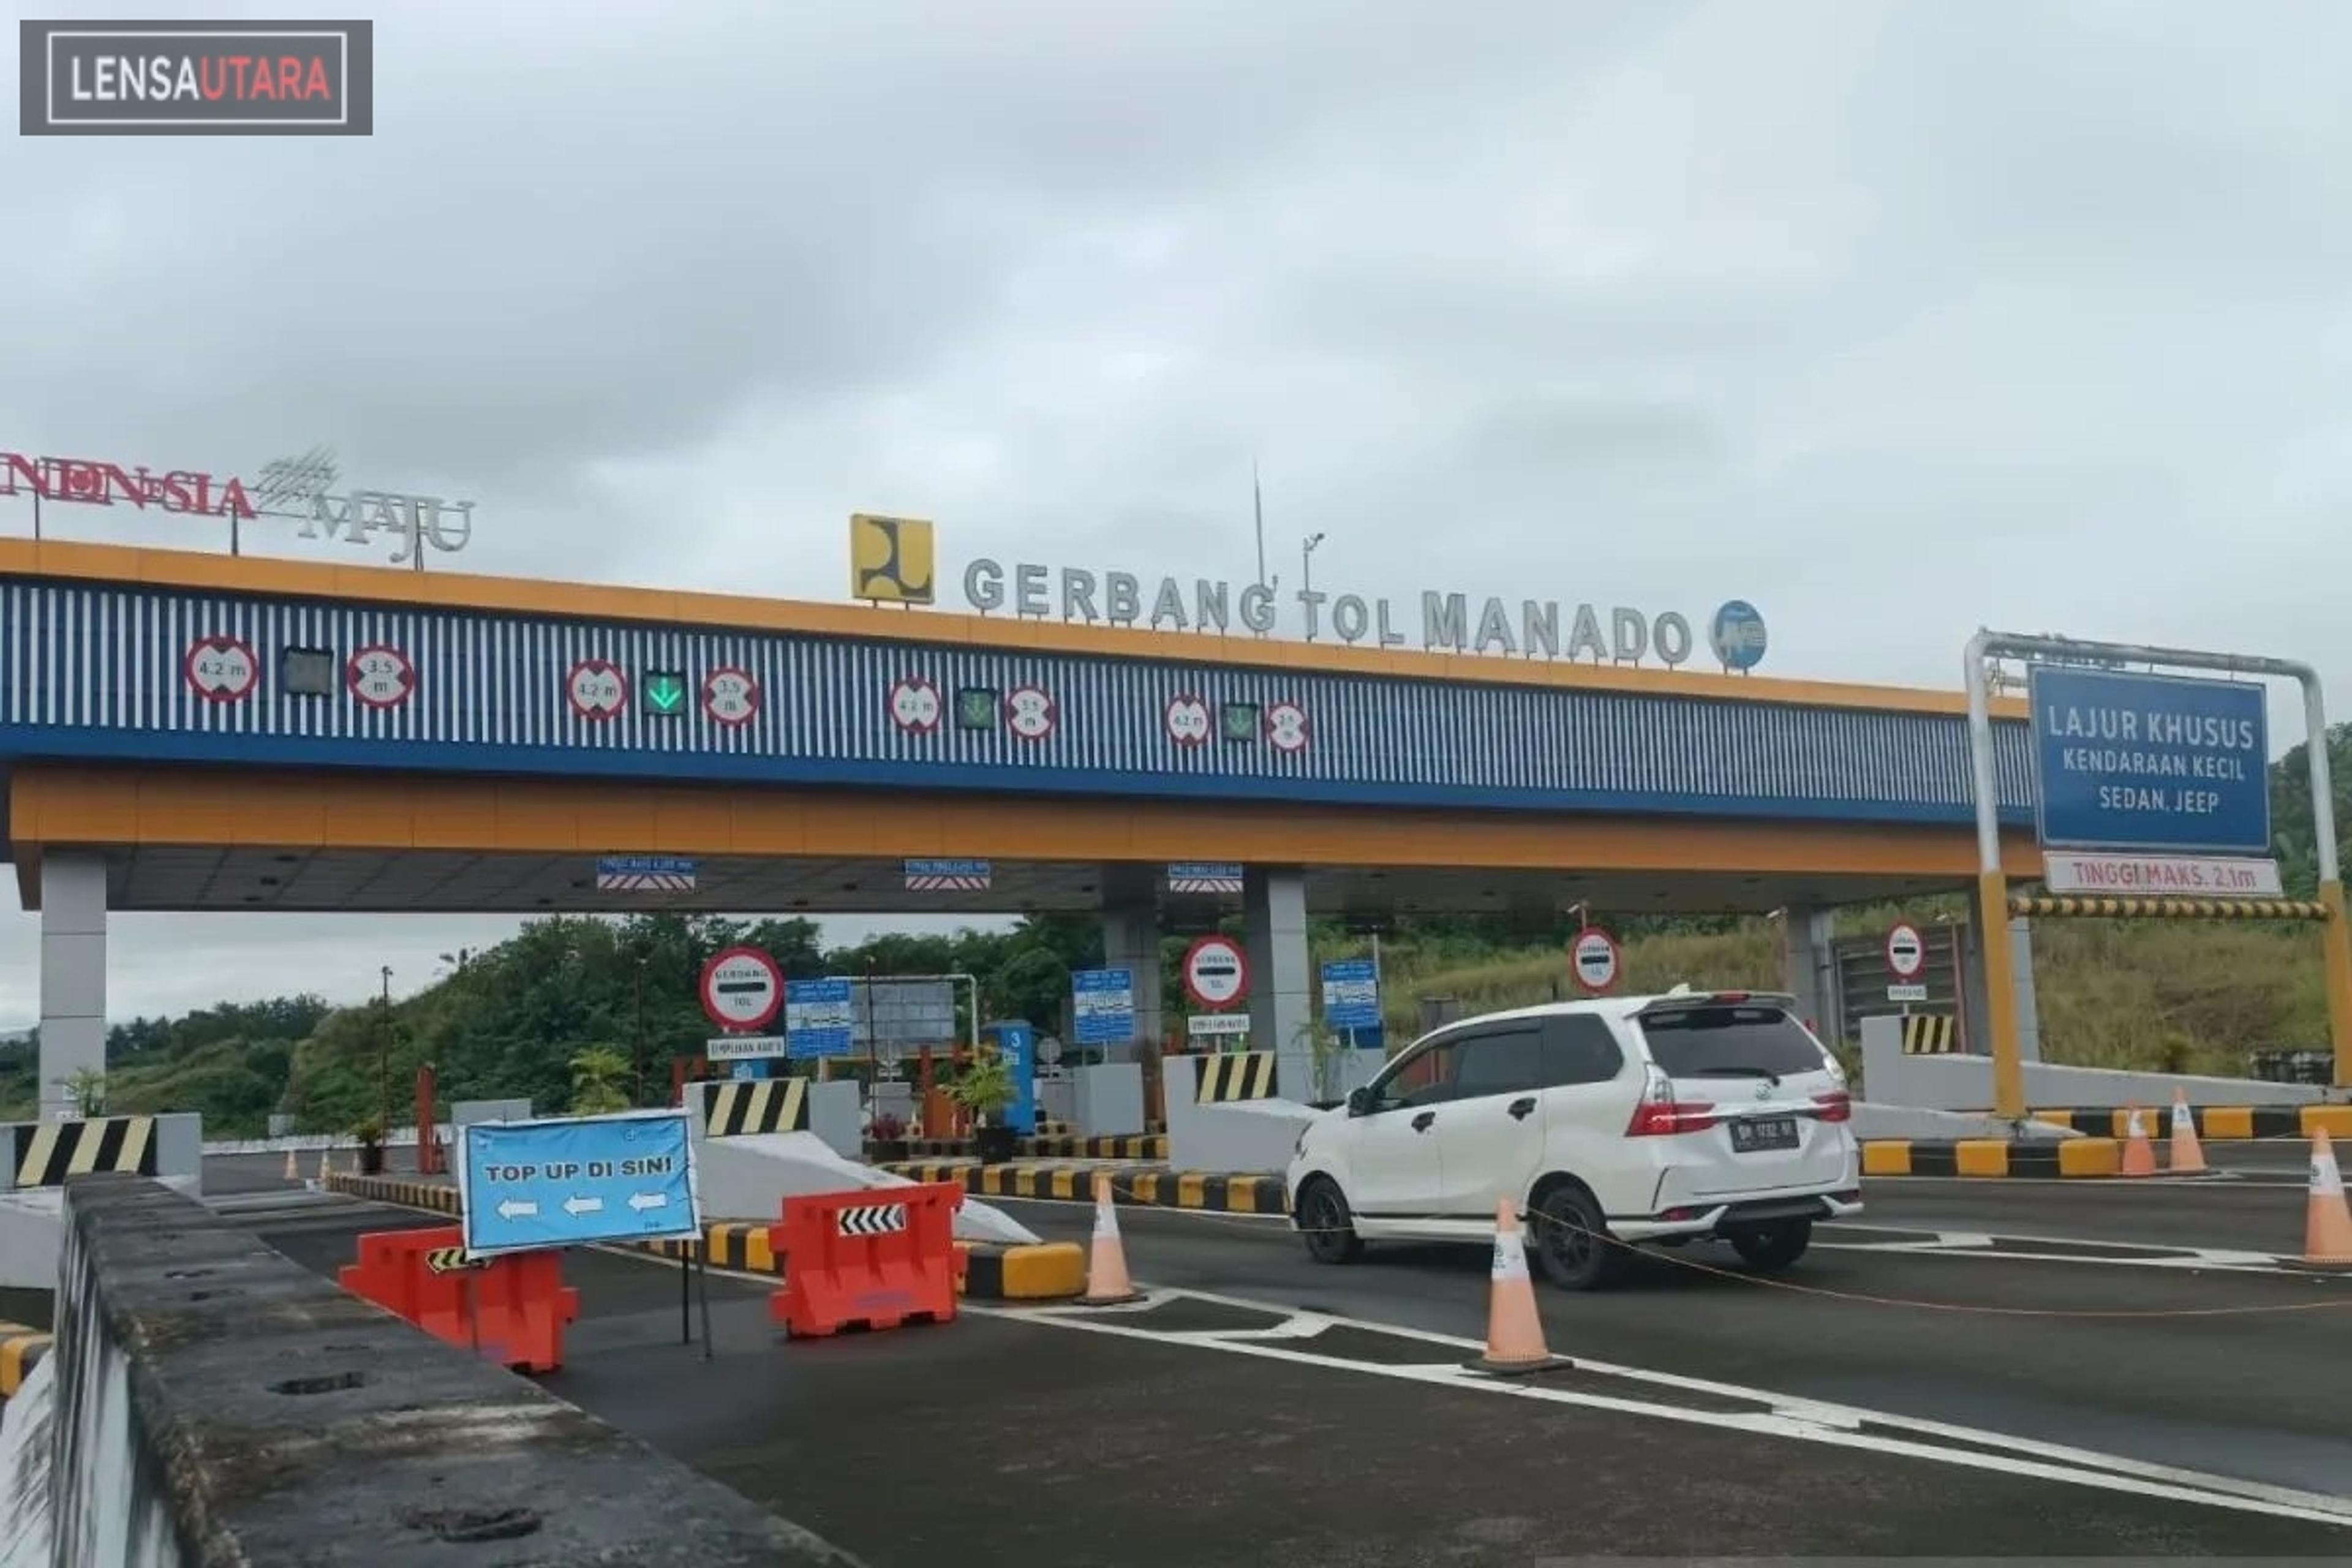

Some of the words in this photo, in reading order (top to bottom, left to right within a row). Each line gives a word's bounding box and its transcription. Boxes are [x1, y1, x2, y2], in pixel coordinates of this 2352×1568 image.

[298, 491, 476, 563] MAJU
[964, 558, 1276, 632] GERBANG
[1297, 589, 1405, 644] TOL
[1423, 590, 1692, 663] MANADO
[2048, 705, 2139, 741] LAJUR
[2147, 712, 2255, 750] KHUSUS
[2063, 748, 2187, 777] KENDARAAN
[2192, 756, 2246, 782] KECIL
[2174, 789, 2220, 814] JEEP
[2071, 862, 2139, 886] TINGGI
[486, 1165, 537, 1182] TOP
[546, 1163, 579, 1180] UP
[589, 1162, 612, 1177] DI
[621, 1156, 672, 1175] SINI
